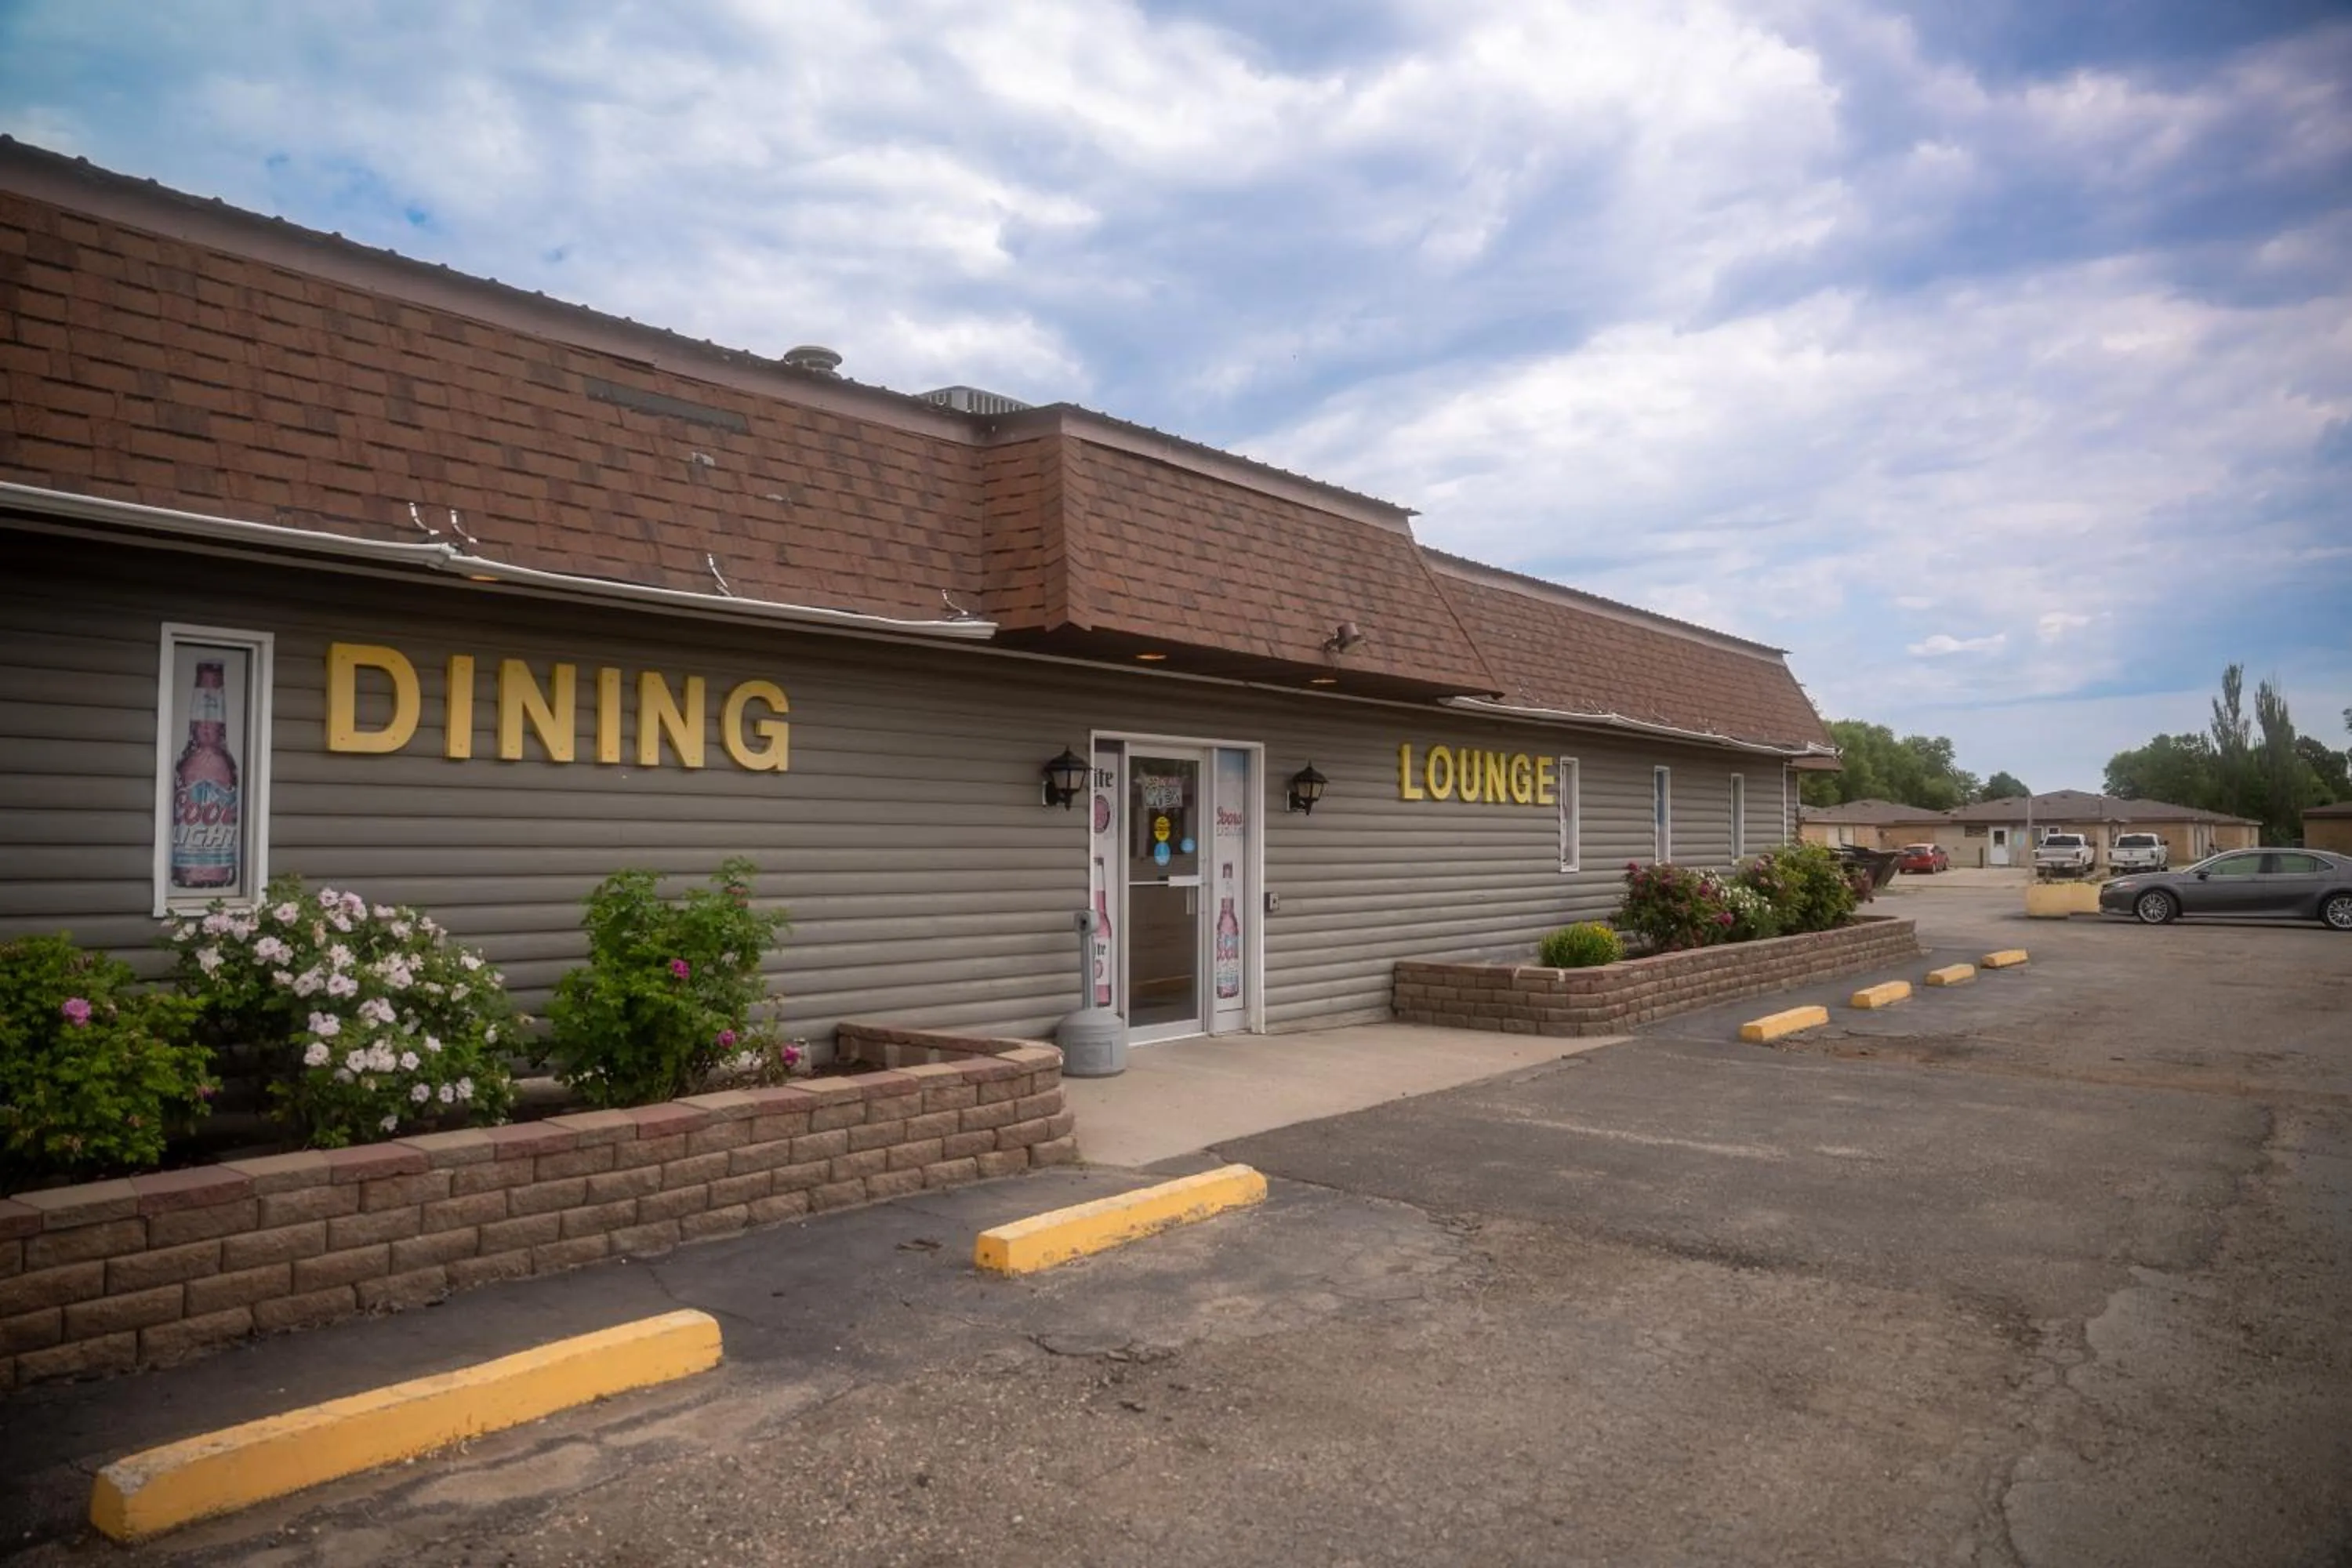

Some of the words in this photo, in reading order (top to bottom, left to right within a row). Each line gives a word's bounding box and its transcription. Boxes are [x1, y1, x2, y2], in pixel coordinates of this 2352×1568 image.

[325, 642, 789, 771] DINING
[1094, 768, 1113, 787] ite
[1400, 744, 1555, 804] LOUNGE
